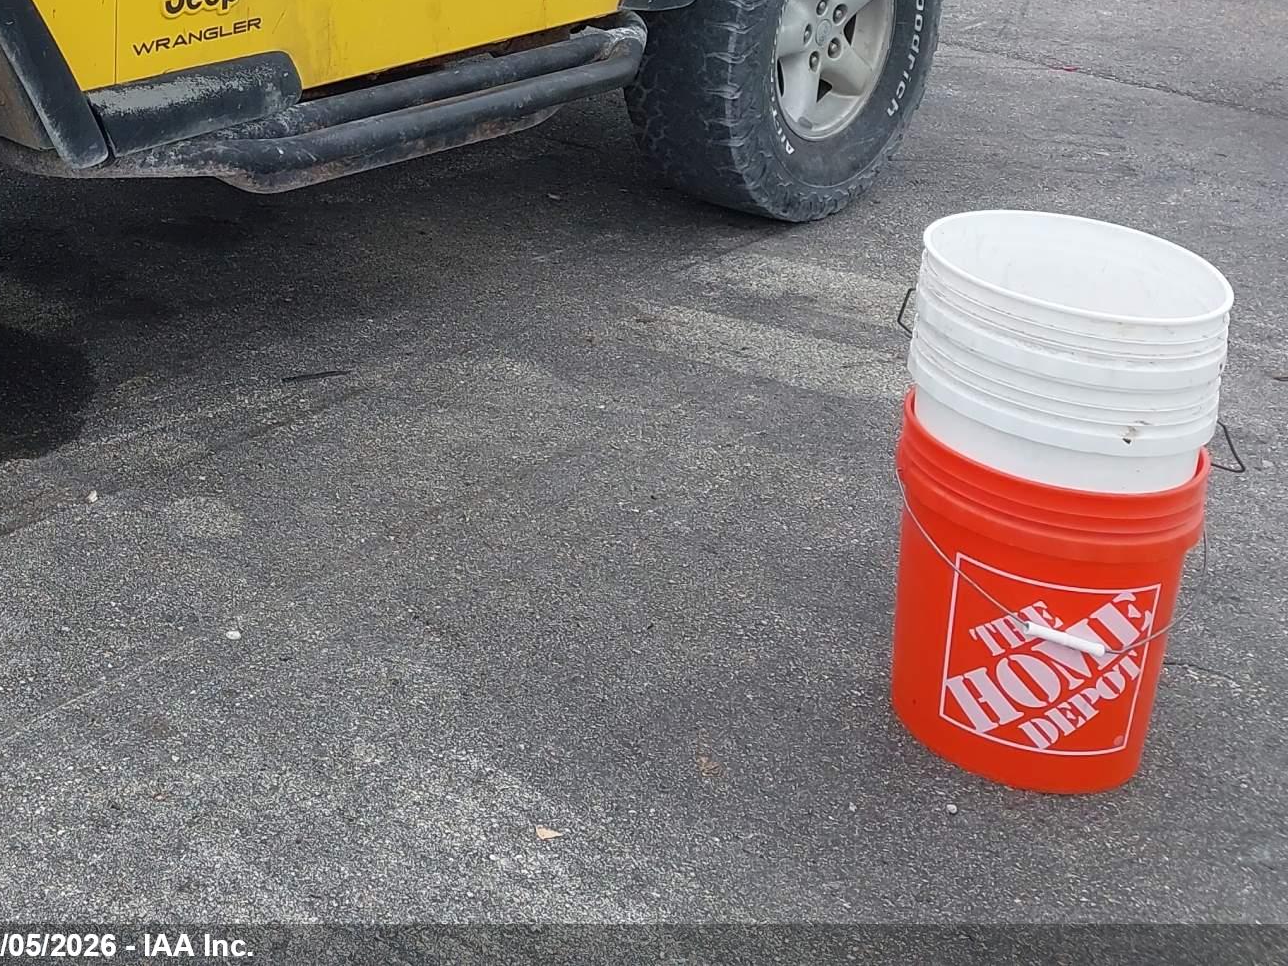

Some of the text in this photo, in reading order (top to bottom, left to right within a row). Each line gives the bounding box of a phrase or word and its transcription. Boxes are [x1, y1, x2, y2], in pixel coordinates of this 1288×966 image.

[133, 17, 262, 56] WRANGLER
[944, 591, 1152, 733] HOME
[968, 600, 1064, 656] THE
[1018, 649, 1142, 750] DEPOT
